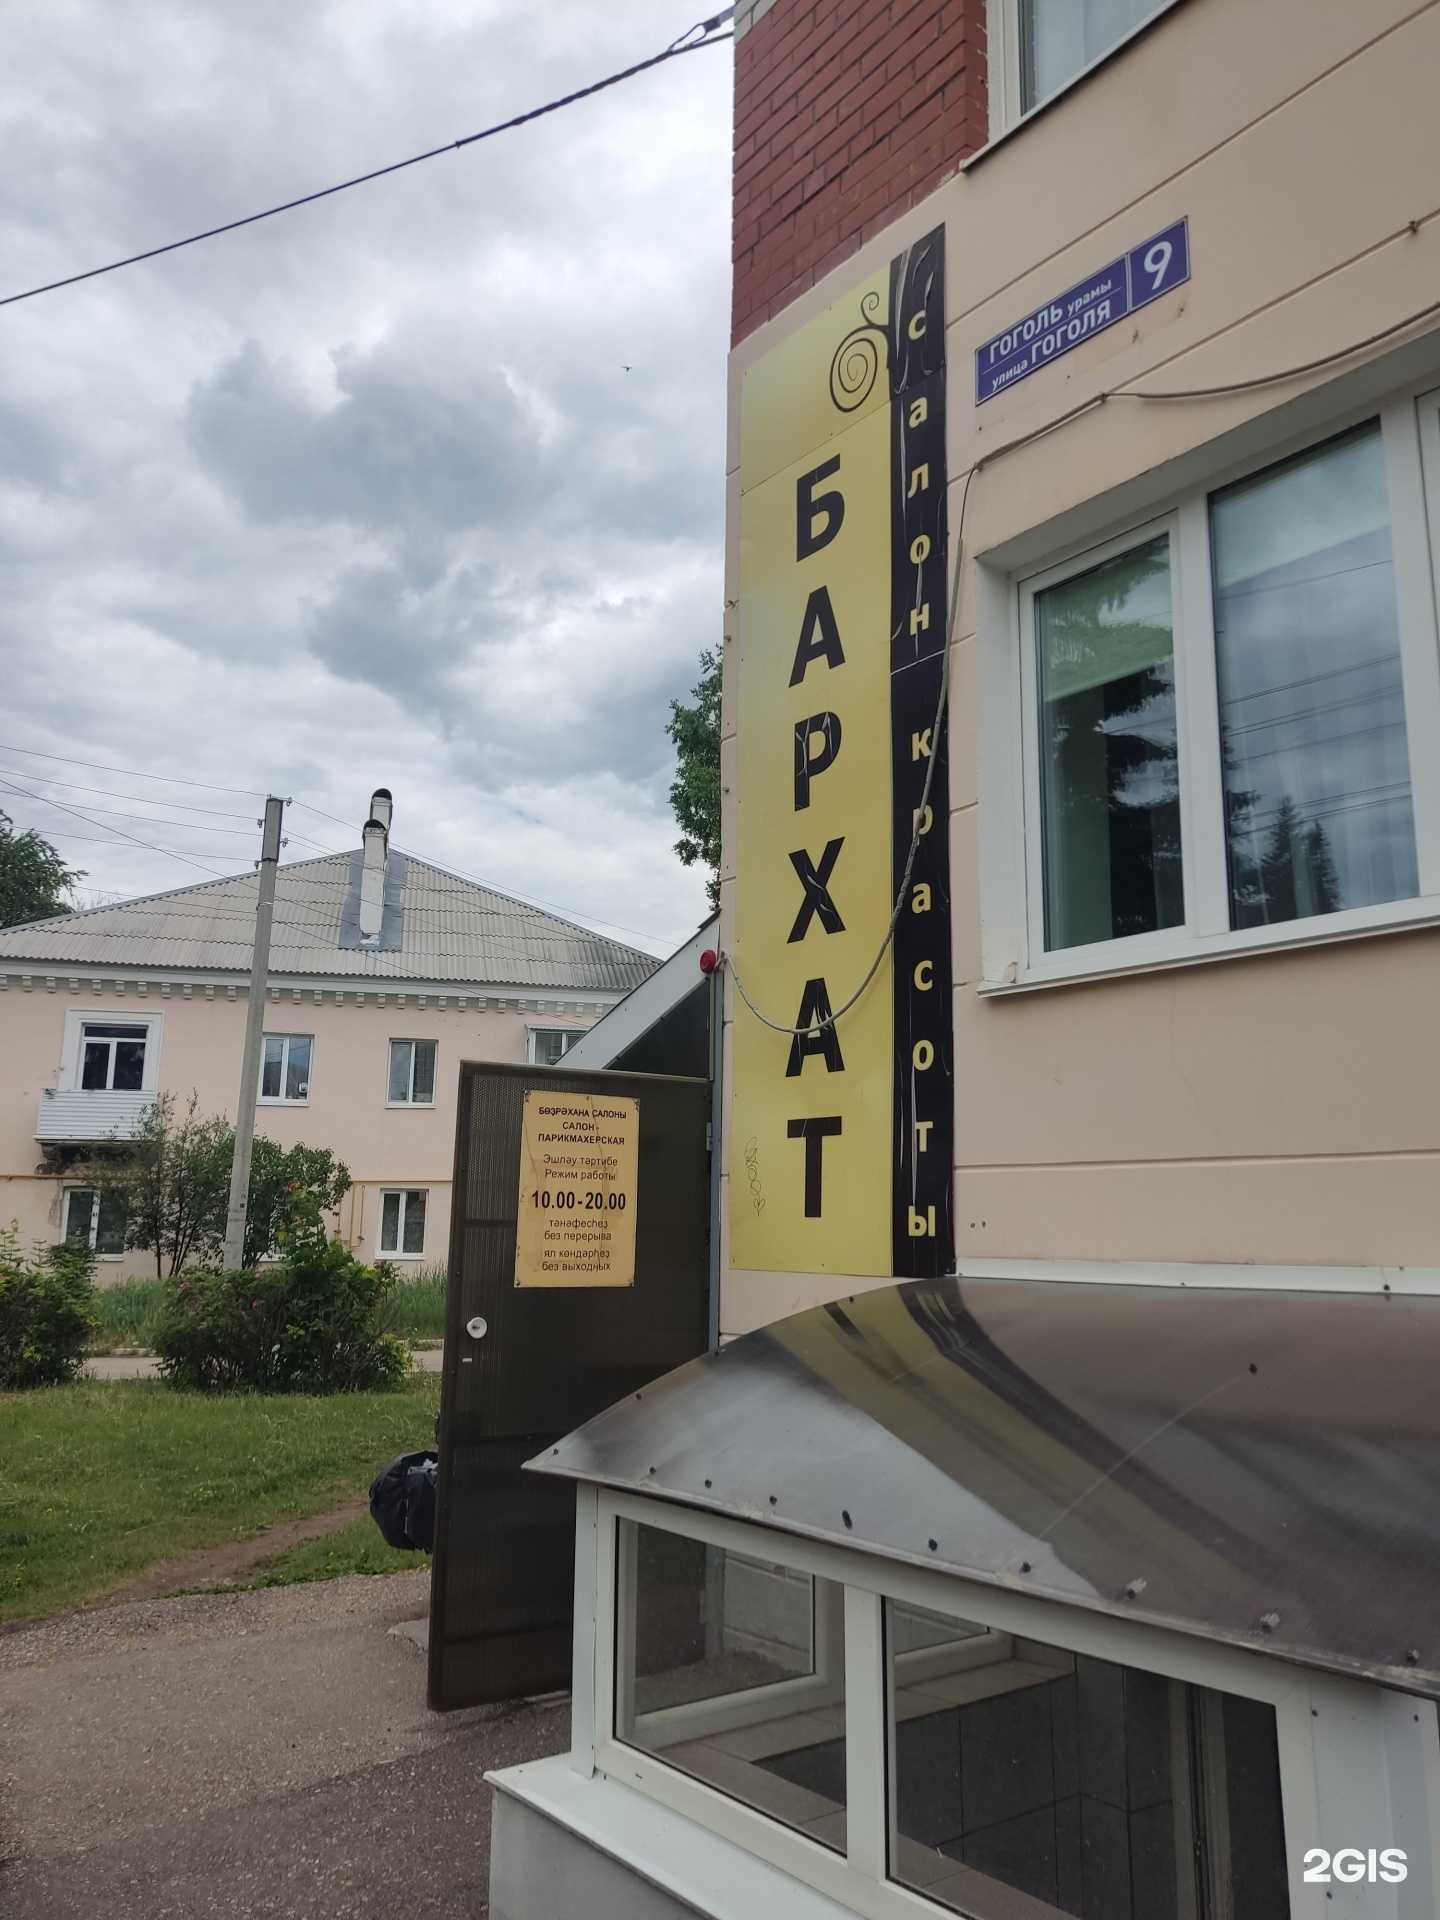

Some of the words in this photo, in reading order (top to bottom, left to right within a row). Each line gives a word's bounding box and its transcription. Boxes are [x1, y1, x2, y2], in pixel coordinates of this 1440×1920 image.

[1143, 241, 1173, 291] 9
[989, 303, 1063, 364] ГОГОЛЬ
[1067, 279, 1112, 316] урамы
[992, 359, 1028, 391] улица
[1031, 299, 1111, 364] ГОГОЛЯ
[907, 309, 931, 637] салон
[785, 453, 846, 1219] БАРХАТ
[592, 1109, 627, 1119] САЛОНЫ
[538, 1133, 625, 1145] ПАРИКМАХЕРСКАЯ
[544, 1168, 578, 1179] Режим
[581, 1169, 616, 1181] работы
[544, 1230, 561, 1241] без
[564, 1232, 612, 1243] перерыва
[544, 1249, 556, 1258] ял
[542, 1261, 559, 1271] без
[561, 1262, 611, 1273] выходных
